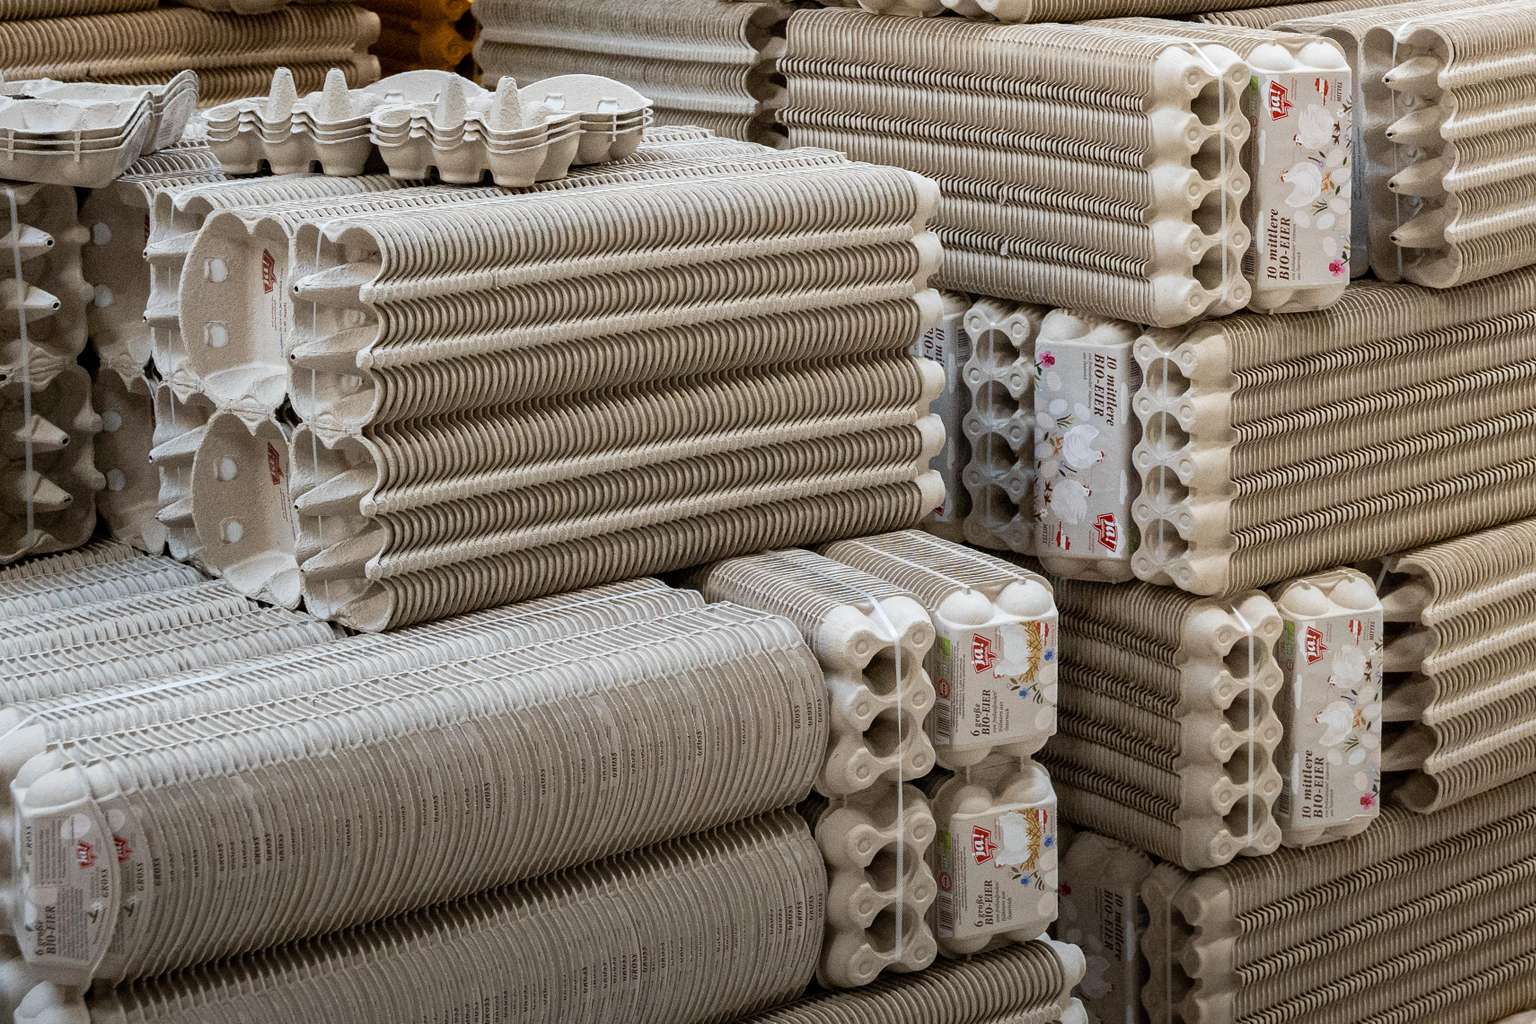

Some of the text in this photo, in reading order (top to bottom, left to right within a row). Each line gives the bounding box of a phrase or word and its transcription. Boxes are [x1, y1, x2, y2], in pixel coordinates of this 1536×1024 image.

[1270, 87, 1282, 114] ja!
[1267, 208, 1279, 280] 10 mittlere
[1279, 217, 1290, 280] BIO-EIER
[1094, 353, 1105, 417] BIO-EIER
[1106, 355, 1118, 427] 10 mittlere
[1103, 520, 1117, 545] ja!
[971, 641, 985, 667] ja!
[1307, 633, 1319, 660] ja!
[973, 704, 983, 728] große
[982, 689, 991, 735] BIO-EIER
[1301, 750, 1313, 819] 10 mittlere
[1313, 756, 1325, 818] BIO-EIER
[971, 833, 986, 857] ja!
[100, 868, 109, 898] GROSS
[984, 880, 993, 925] BIO-EIER
[976, 895, 985, 918] große
[1104, 889, 1114, 950] BIO-EIER
[1114, 894, 1123, 961] 10 mittlere
[36, 948, 44, 956] 6
[46, 905, 57, 954] BIO-EIER
